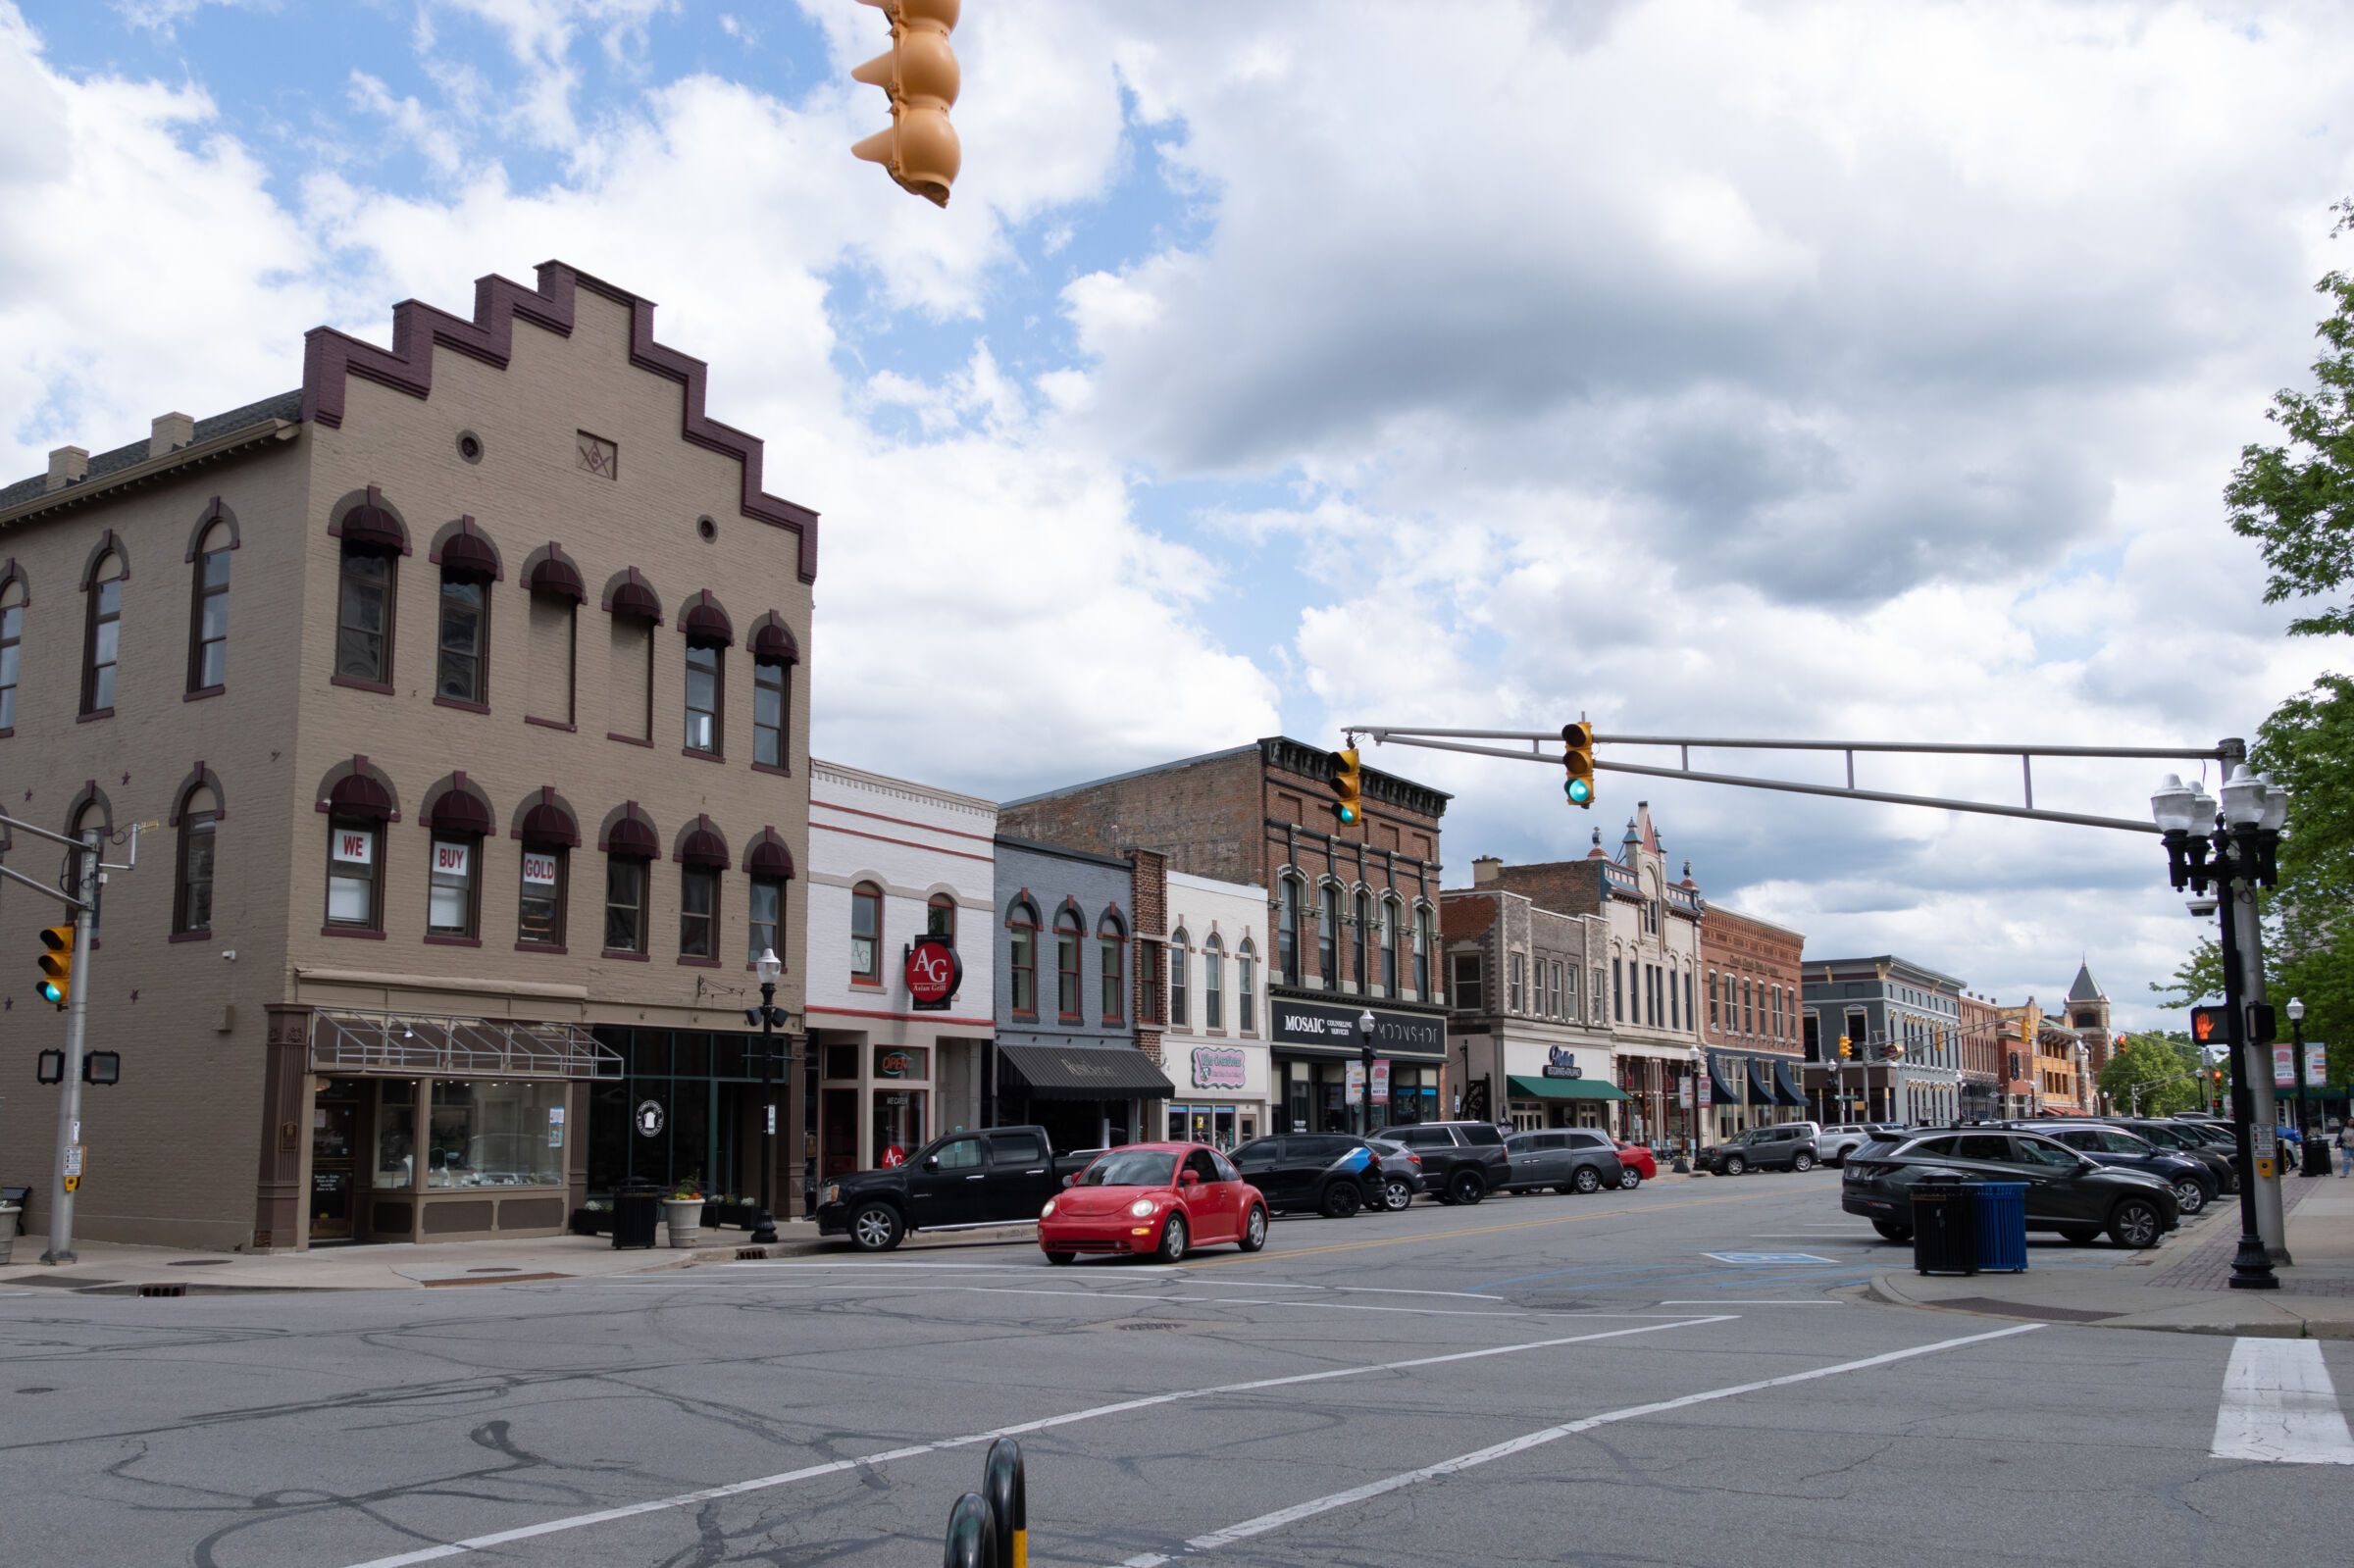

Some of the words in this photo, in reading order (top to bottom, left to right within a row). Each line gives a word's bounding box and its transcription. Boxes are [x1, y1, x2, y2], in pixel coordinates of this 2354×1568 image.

[343, 835, 363, 857] WE
[439, 848, 464, 869] BUY
[525, 859, 554, 880] GOLD
[912, 948, 947, 983] AG
[1285, 1015, 1325, 1034] MOSAIC
[1327, 1020, 1353, 1029] COUNSELING
[883, 1057, 907, 1070] OPEN
